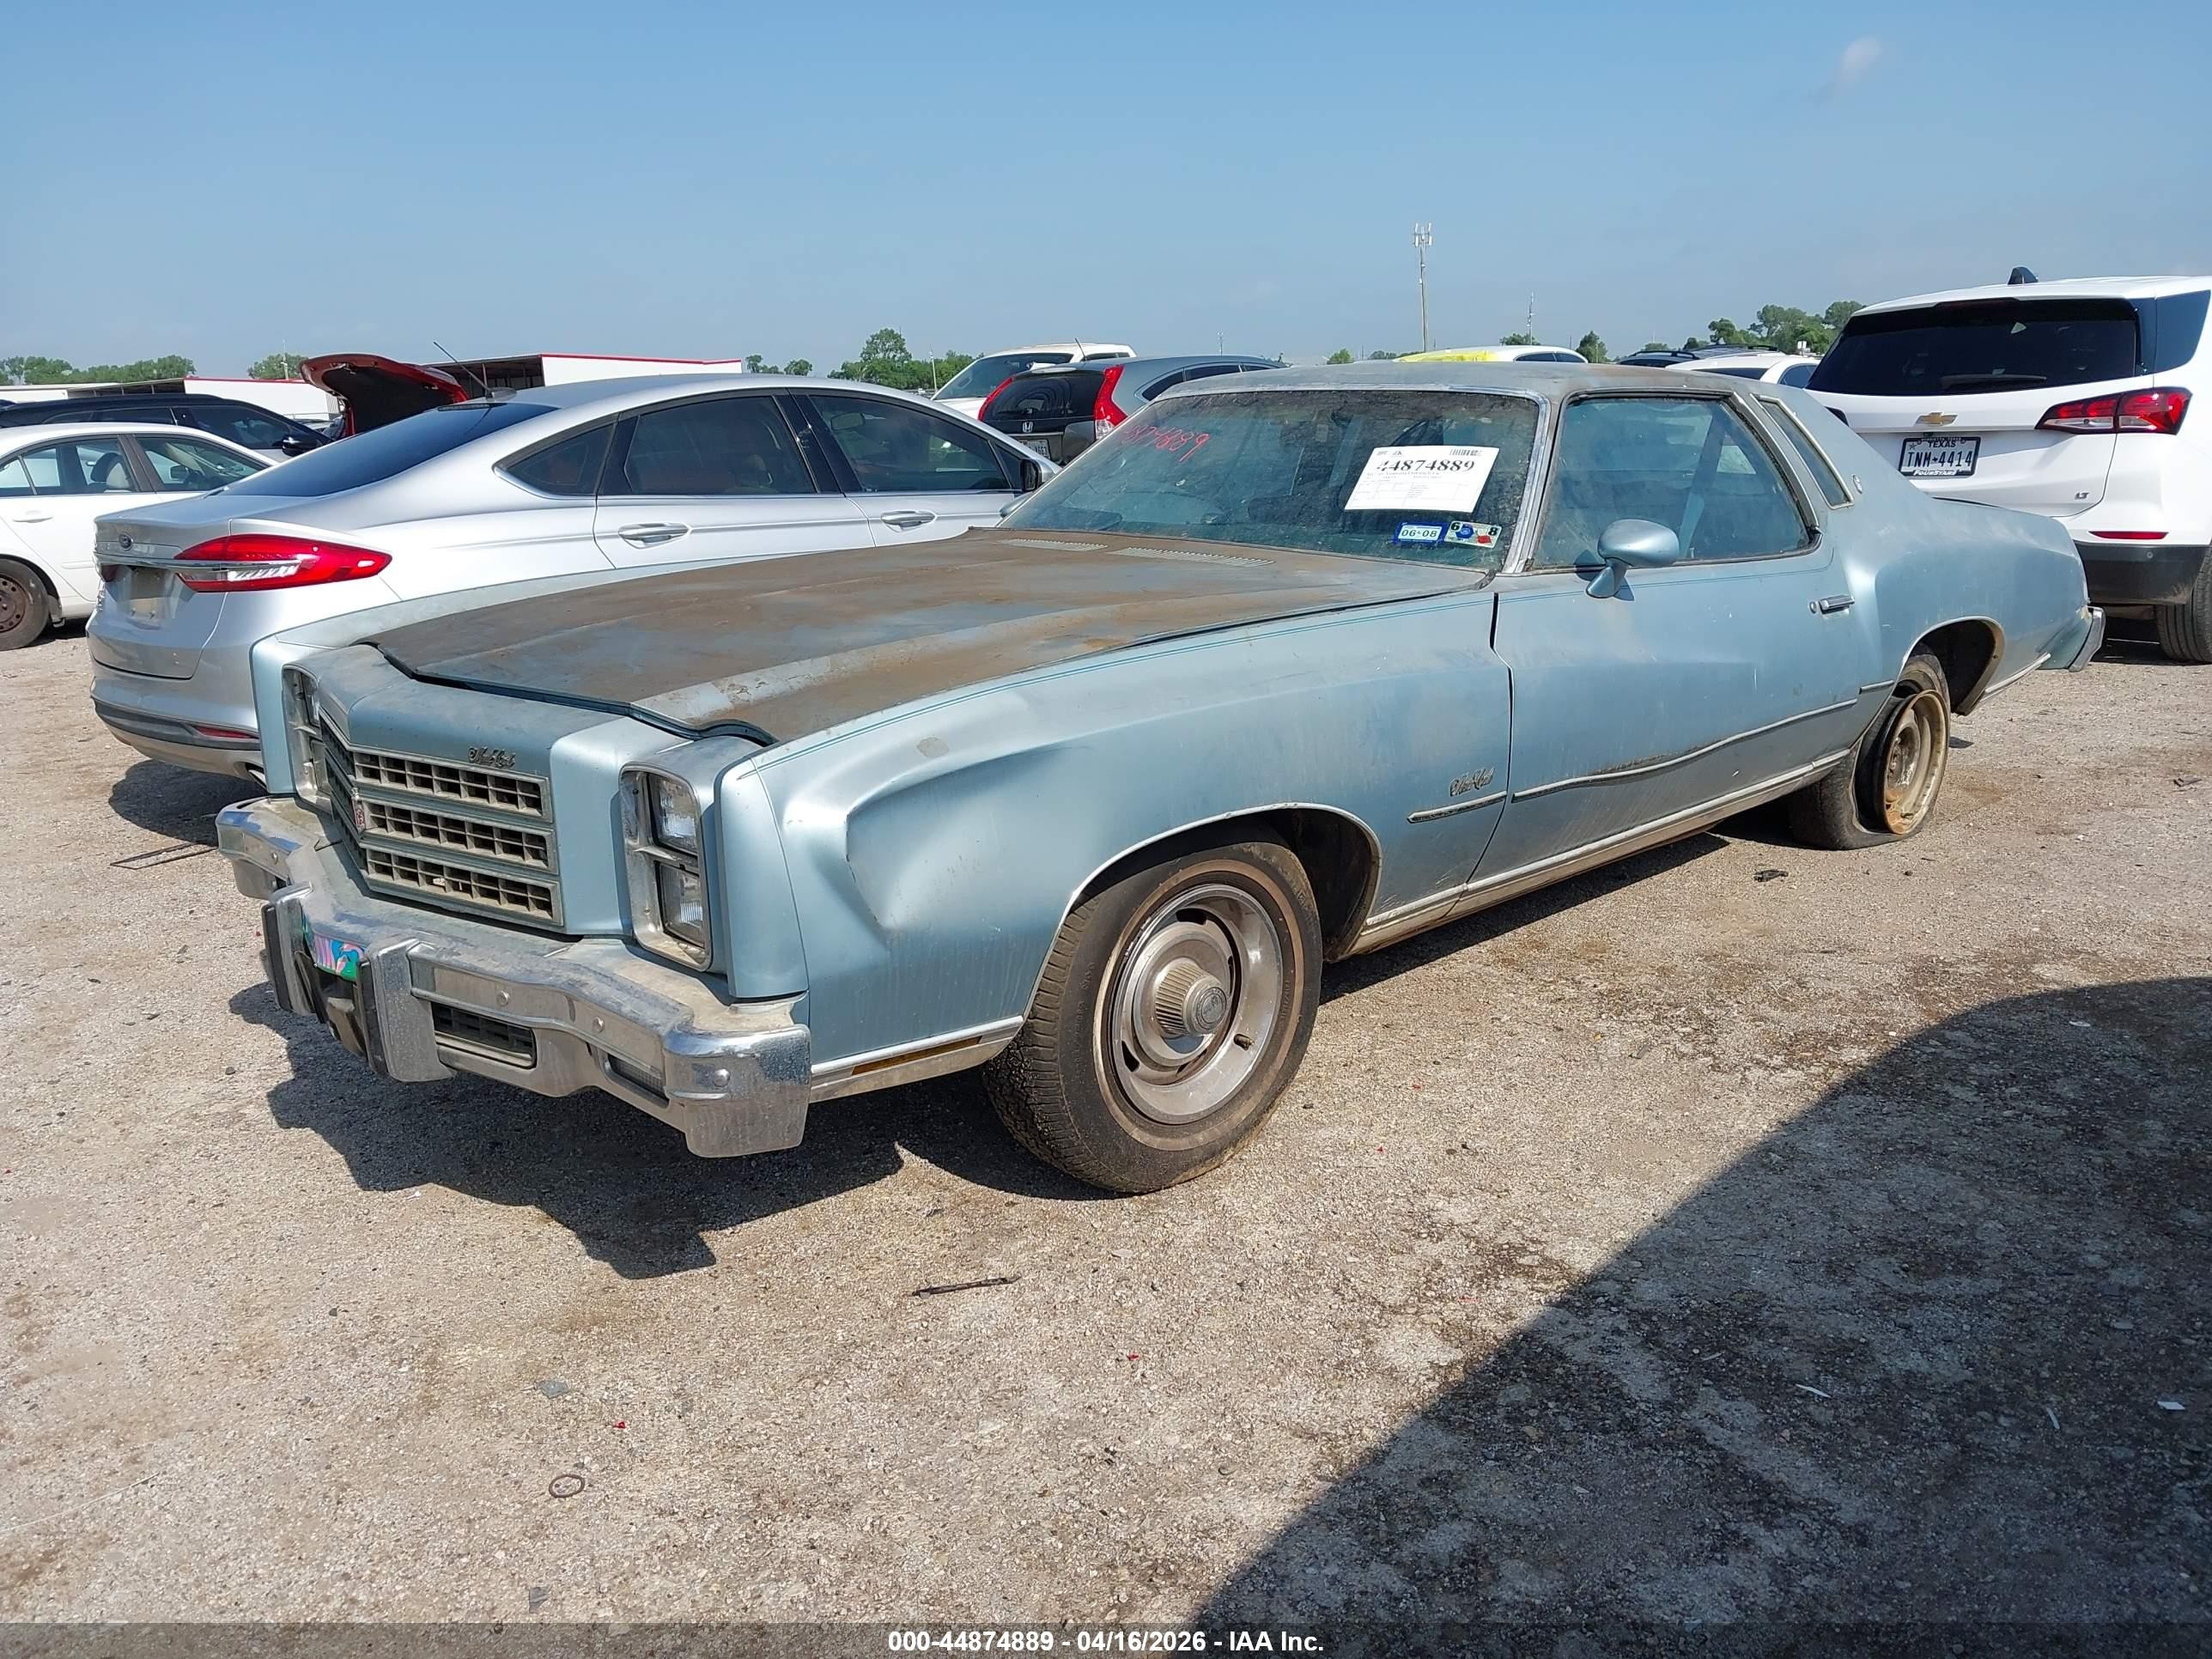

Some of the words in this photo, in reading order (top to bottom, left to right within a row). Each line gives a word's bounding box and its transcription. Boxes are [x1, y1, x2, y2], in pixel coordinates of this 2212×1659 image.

[1376, 459, 1475, 472] 44874889
[1450, 521, 1461, 532] 6
[1488, 526, 1498, 536] 8
